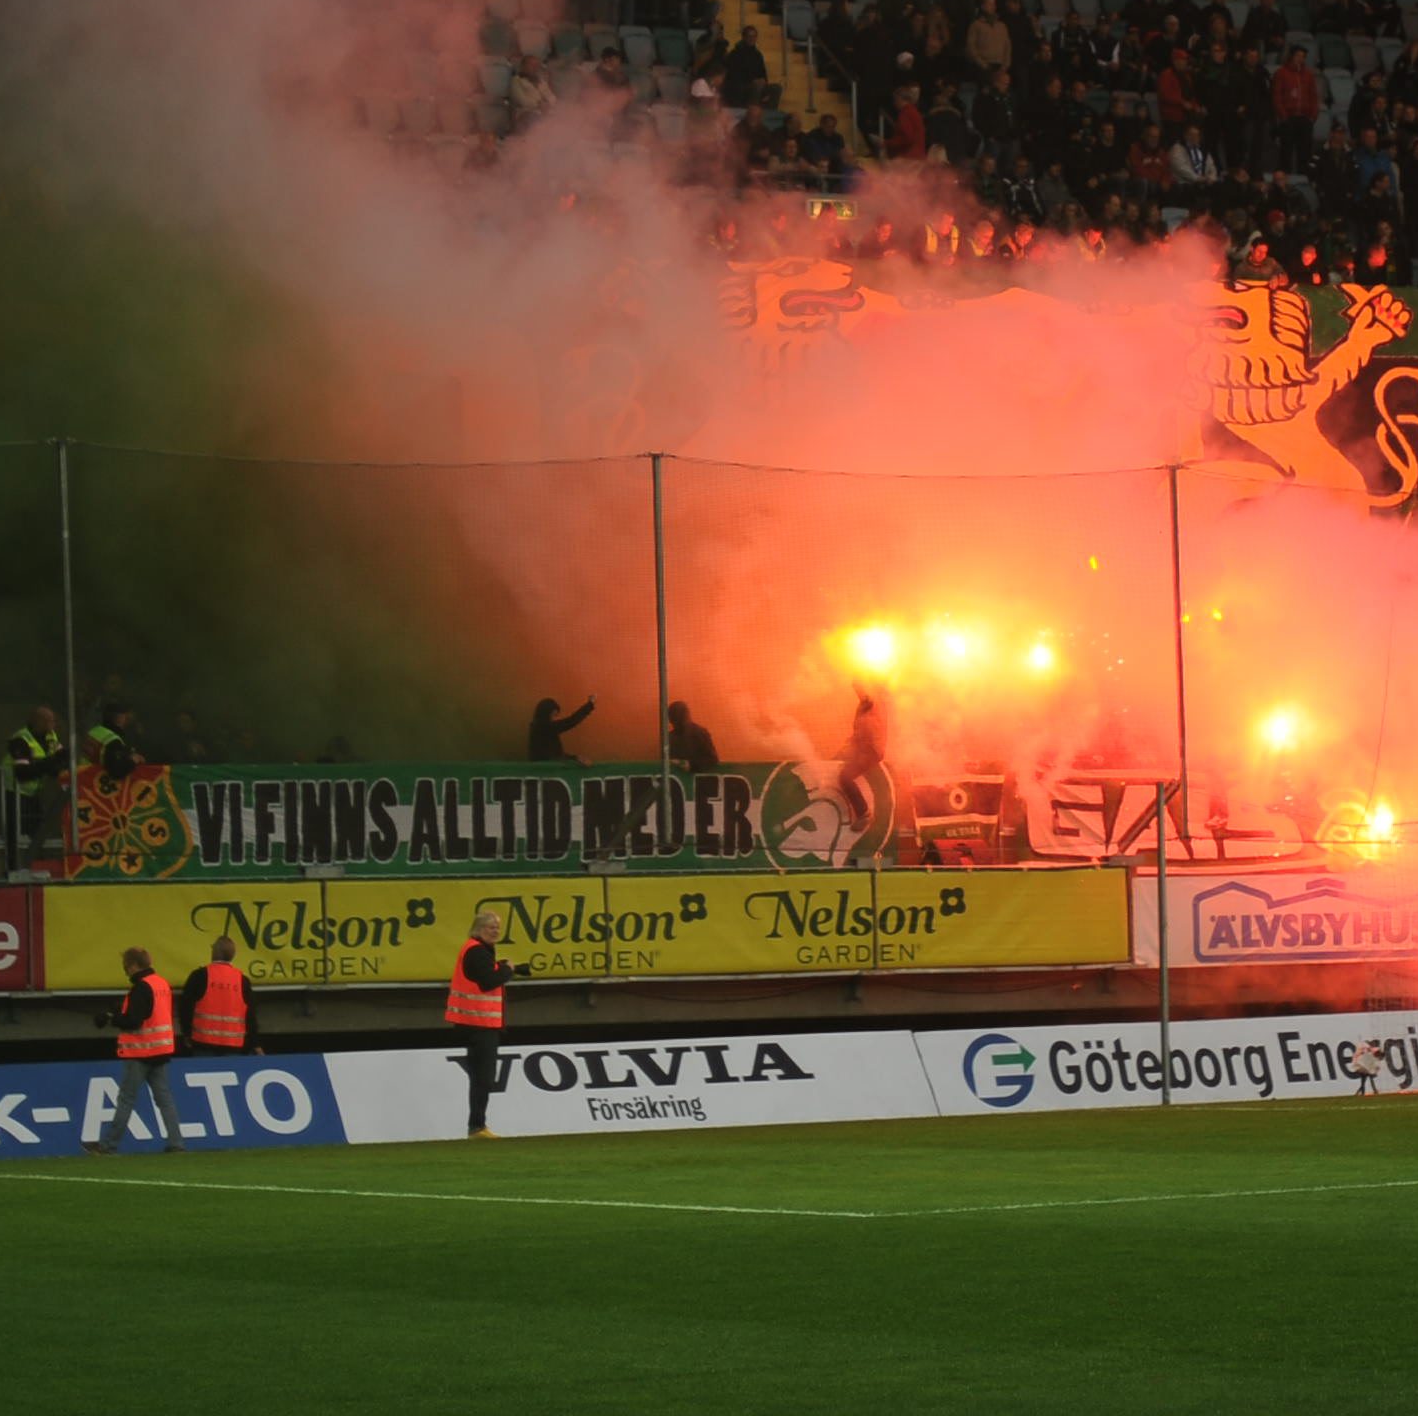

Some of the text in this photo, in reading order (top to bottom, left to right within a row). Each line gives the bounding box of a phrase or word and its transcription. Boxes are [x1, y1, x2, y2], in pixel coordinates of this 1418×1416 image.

[253, 778, 398, 866] FINNS
[407, 776, 571, 866] ALLTID
[581, 773, 686, 862] MED
[693, 772, 754, 857] ER
[191, 900, 401, 950] Nelson
[475, 893, 676, 946] Nelson
[745, 889, 936, 941] Nelson
[249, 956, 380, 979] GARDEN
[529, 950, 656, 972] GARDEN
[796, 943, 917, 966] GARDEN
[446, 1041, 815, 1094] VOLVIA
[1048, 1036, 1273, 1097] Göteborg
[587, 1093, 708, 1123] Försäkring
